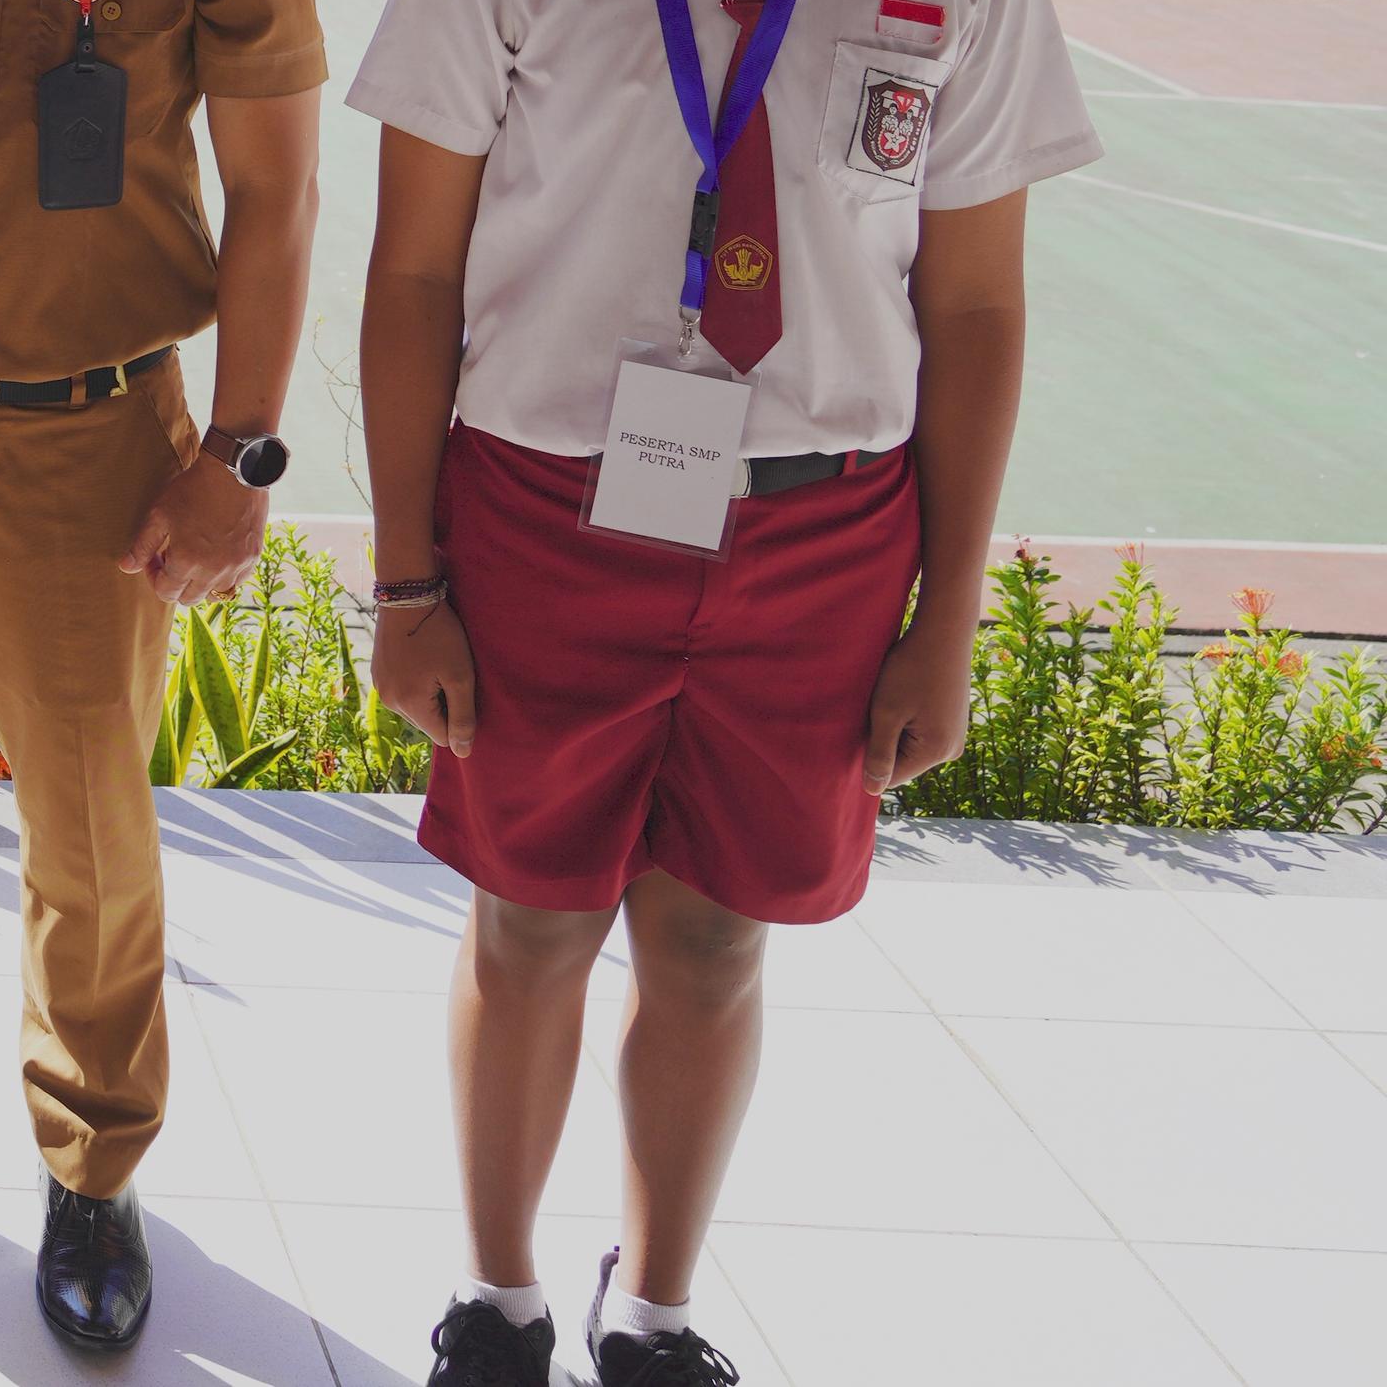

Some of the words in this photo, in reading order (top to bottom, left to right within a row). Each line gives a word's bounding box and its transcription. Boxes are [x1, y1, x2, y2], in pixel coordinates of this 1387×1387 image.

[619, 431, 684, 455] PESERTA
[689, 446, 721, 462] SMP
[638, 451, 685, 470] PUTRA
